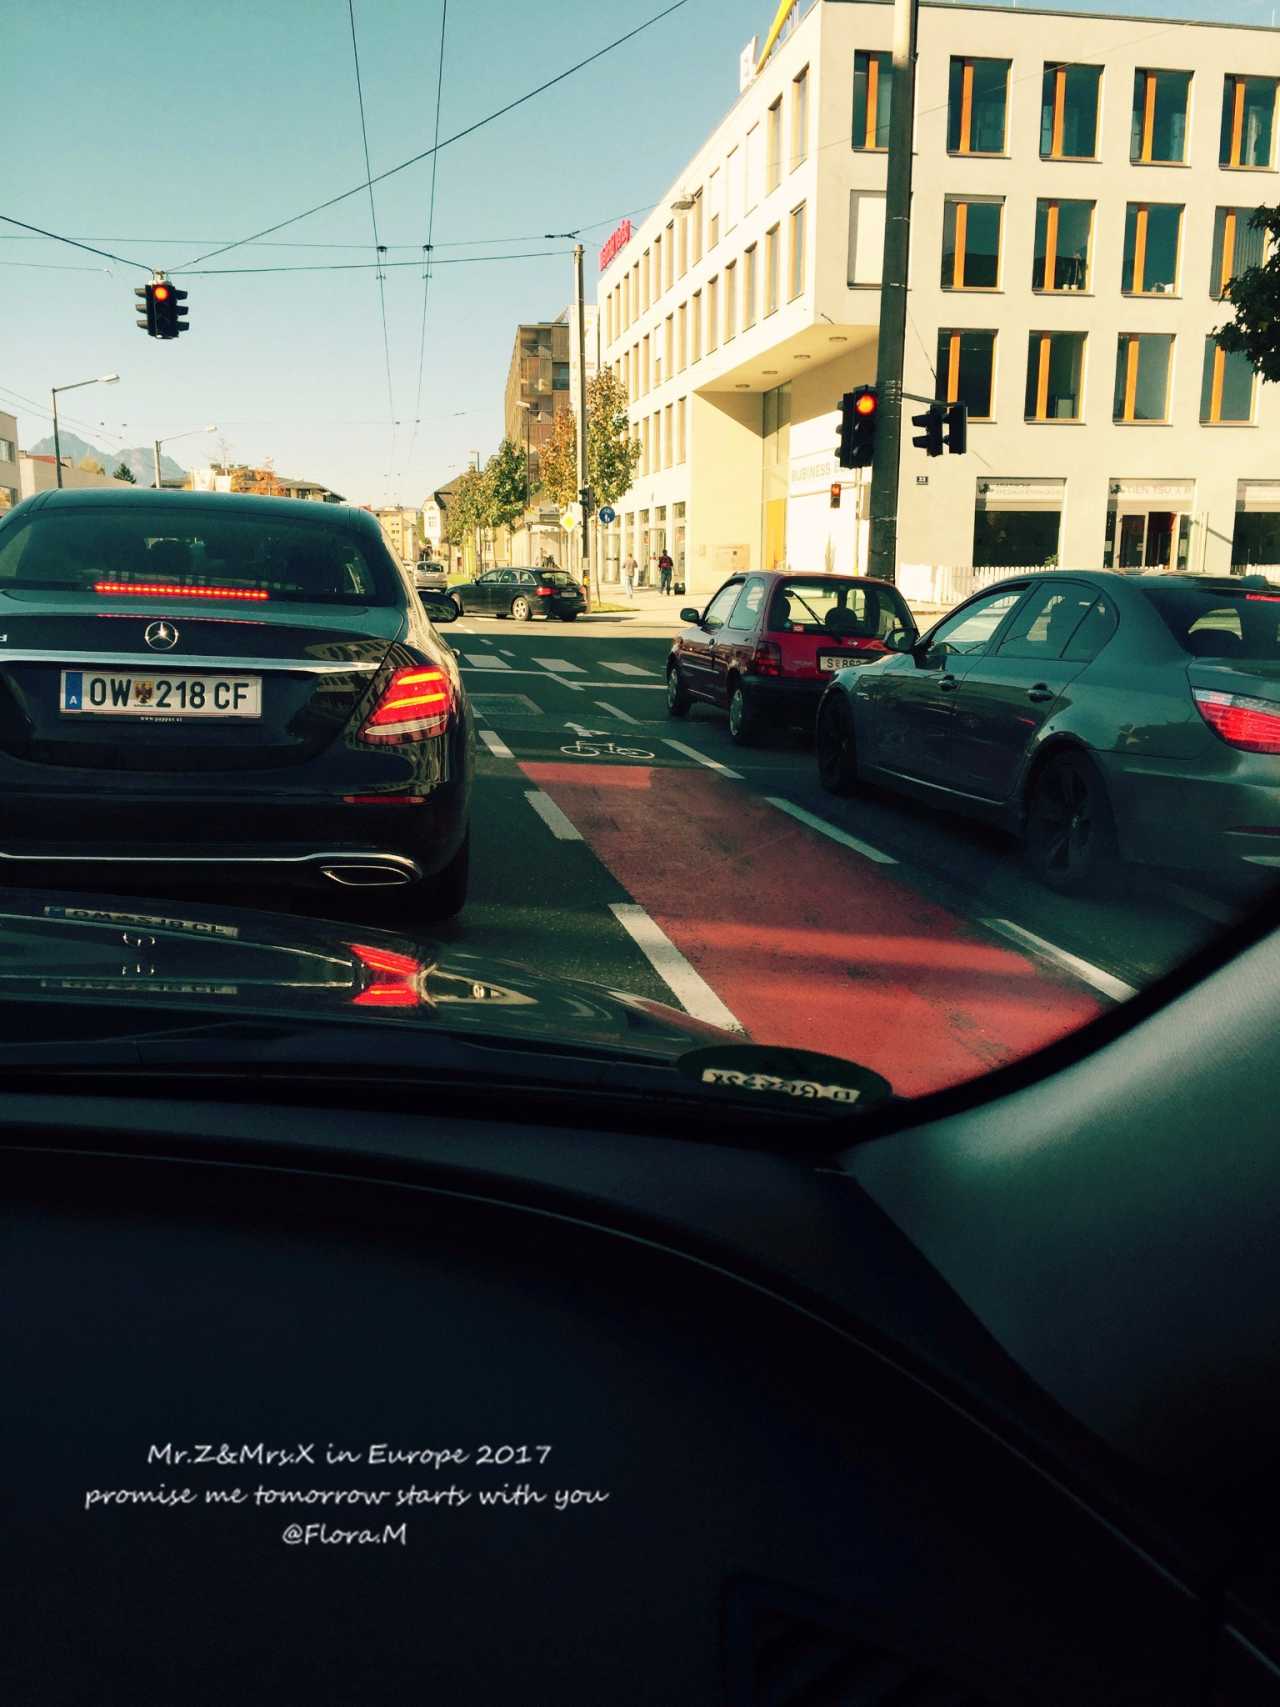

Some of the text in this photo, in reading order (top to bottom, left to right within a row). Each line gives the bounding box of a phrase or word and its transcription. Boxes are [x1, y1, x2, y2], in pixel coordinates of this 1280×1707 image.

[69, 695, 78, 705] A
[90, 678, 249, 709] OW 218 CF
